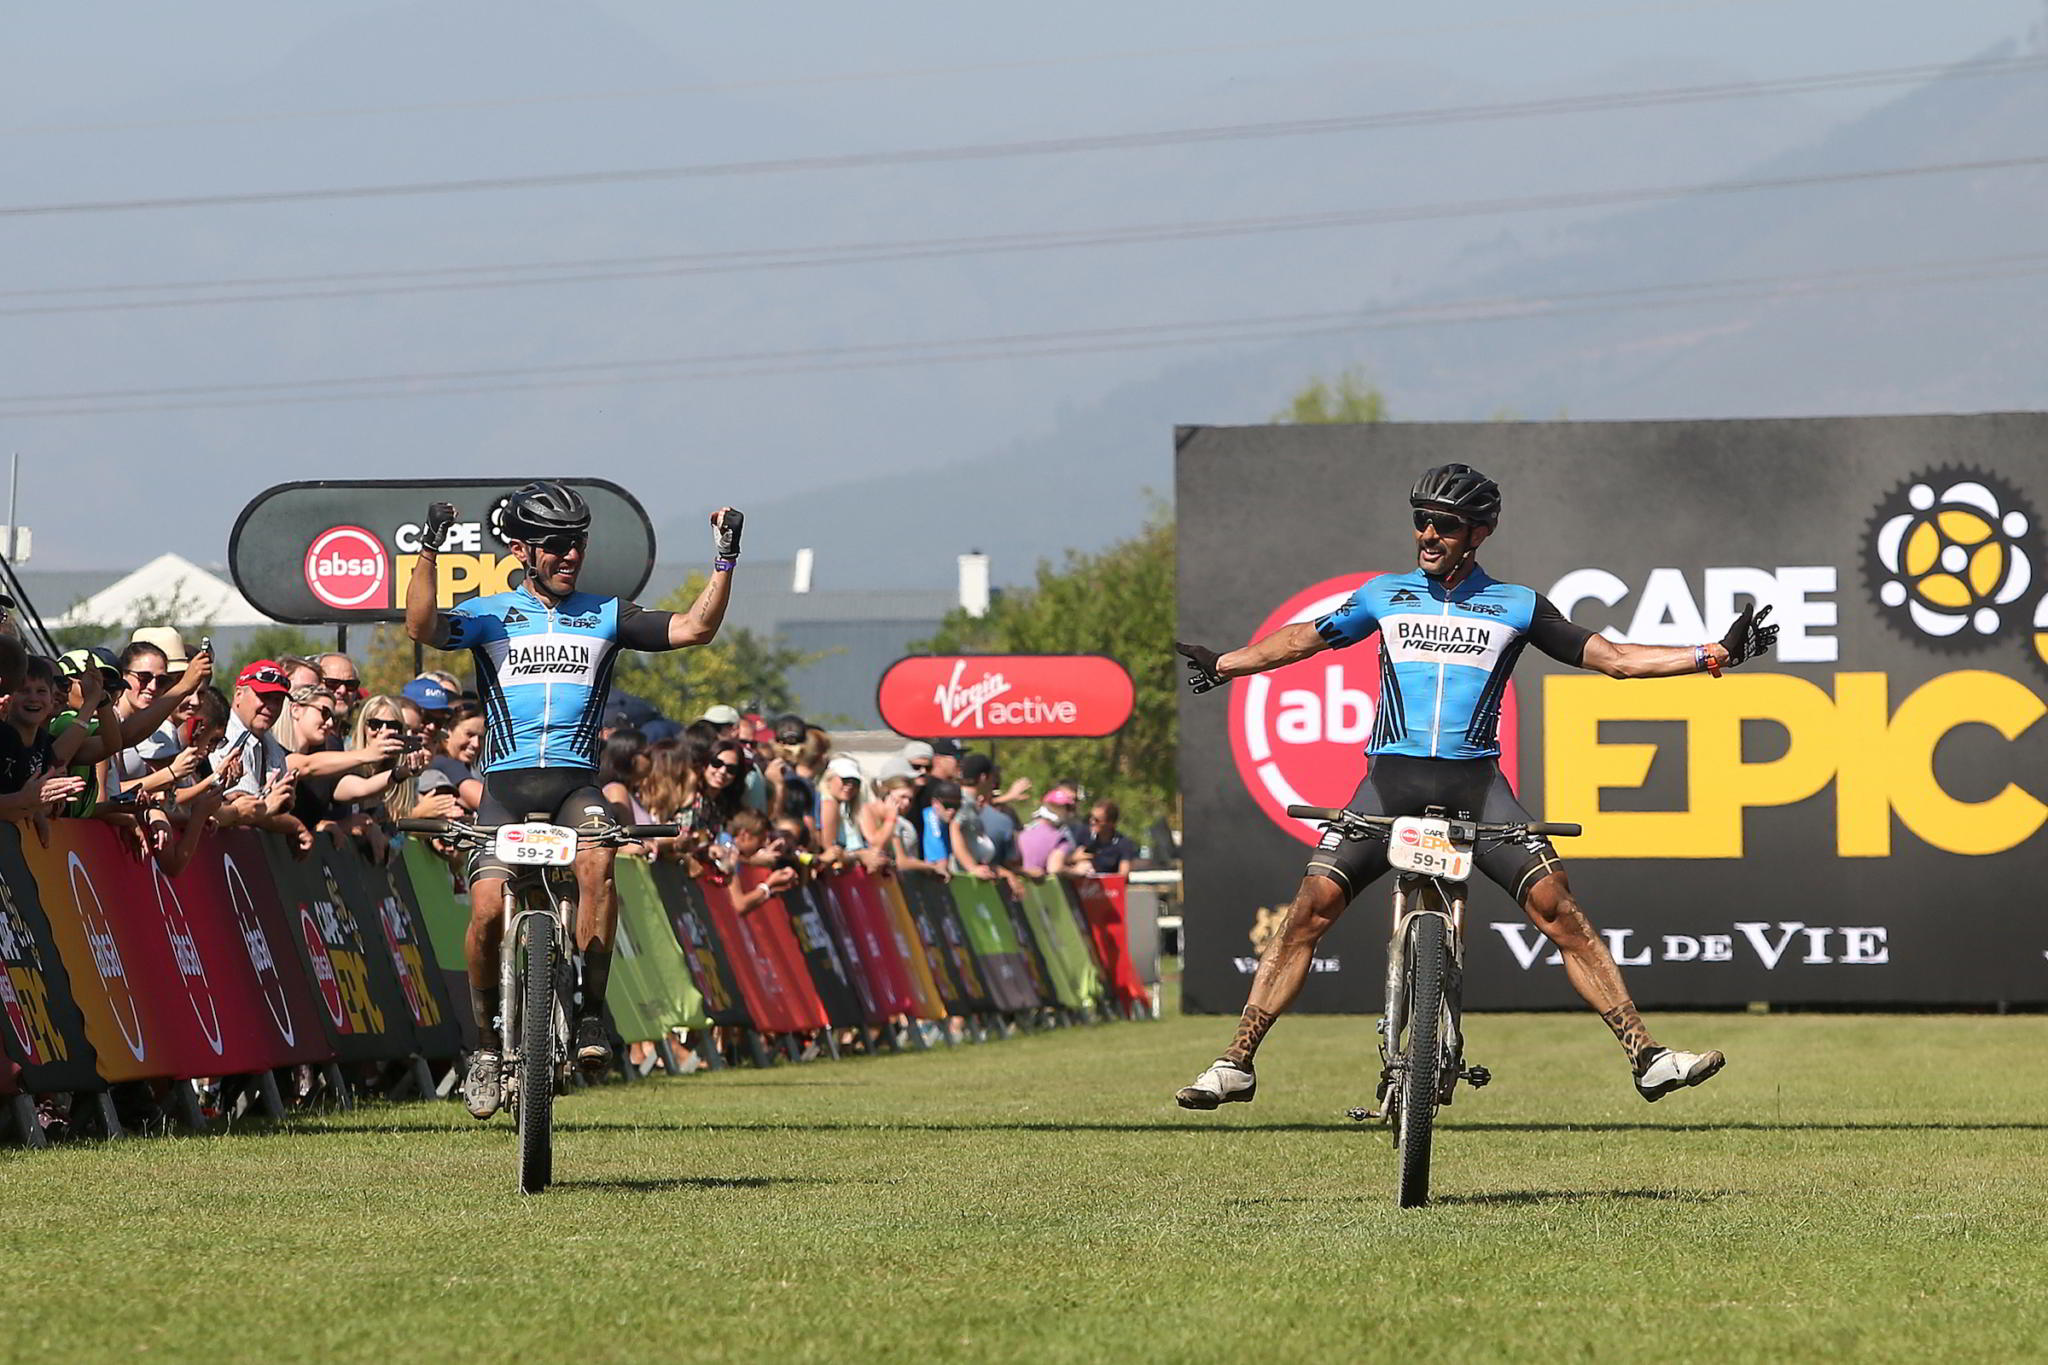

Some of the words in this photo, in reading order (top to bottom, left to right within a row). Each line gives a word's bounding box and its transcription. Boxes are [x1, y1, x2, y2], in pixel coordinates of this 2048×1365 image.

[318, 552, 375, 576] absa
[1399, 622, 1490, 646] BAHRAIN
[508, 645, 589, 665] BAHRAIN
[1402, 639, 1487, 656] MERIDA
[511, 663, 589, 676] MERIDA
[933, 659, 1012, 729] Virgin
[1276, 664, 1375, 744] ab
[988, 695, 1077, 725] active
[1543, 669, 2048, 859] EPIC
[1424, 828, 1446, 839] CAPE
[517, 847, 554, 859] 59-2
[1413, 852, 1447, 870] 59-1
[1490, 921, 1652, 970] VL
[1662, 934, 1734, 962] DE
[1733, 921, 1890, 971] VIE
